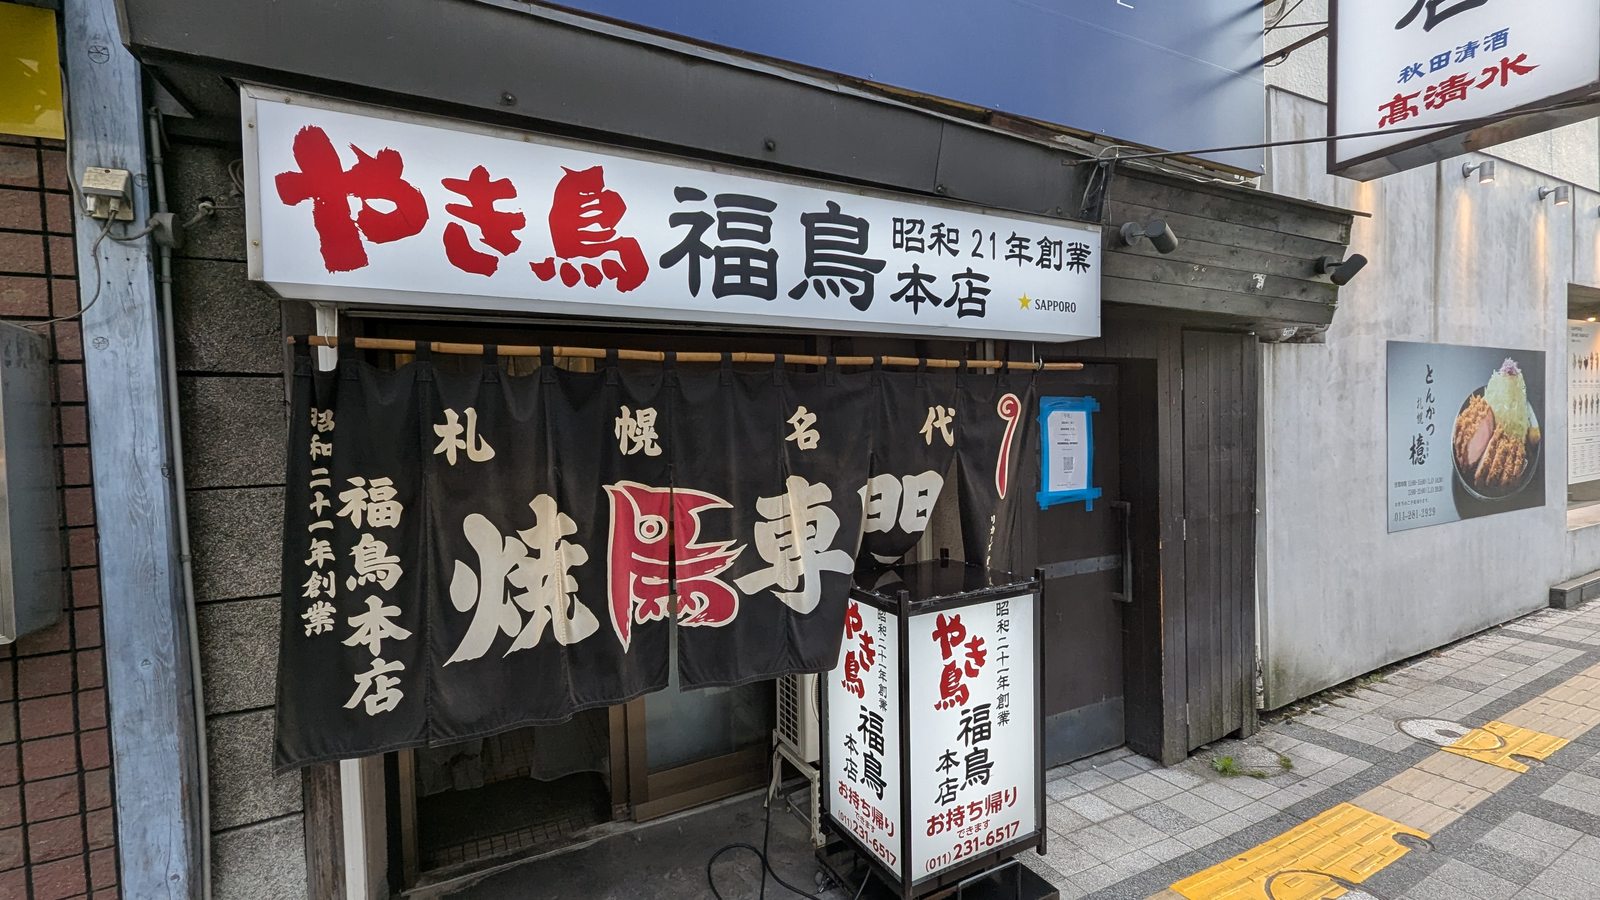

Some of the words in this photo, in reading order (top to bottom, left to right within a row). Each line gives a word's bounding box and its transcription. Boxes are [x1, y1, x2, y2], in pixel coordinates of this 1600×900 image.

[1397, 27, 1509, 84] 秋田清酒
[275, 124, 650, 293] やき鳥
[659, 186, 886, 312] 福鳥
[889, 263, 992, 318] 本店
[1034, 298, 1077, 313] SAPPORO
[1425, 364, 1435, 436] とんかつ
[301, 407, 336, 637] 昭和二十一年創業
[336, 476, 412, 716] 福鳥本店
[842, 601, 876, 699] やき鳥
[932, 612, 987, 711] やき鳥
[996, 600, 1010, 727] 昭和二十一年創業
[843, 733, 858, 783] 本店
[857, 705, 887, 800] 福鳥
[934, 749, 960, 806] 本店
[956, 702, 995, 792] 福鳥
[838, 780, 895, 837] お持ち帰り
[926, 786, 1017, 837] お持ち帰り
[957, 819, 991, 839] できます
